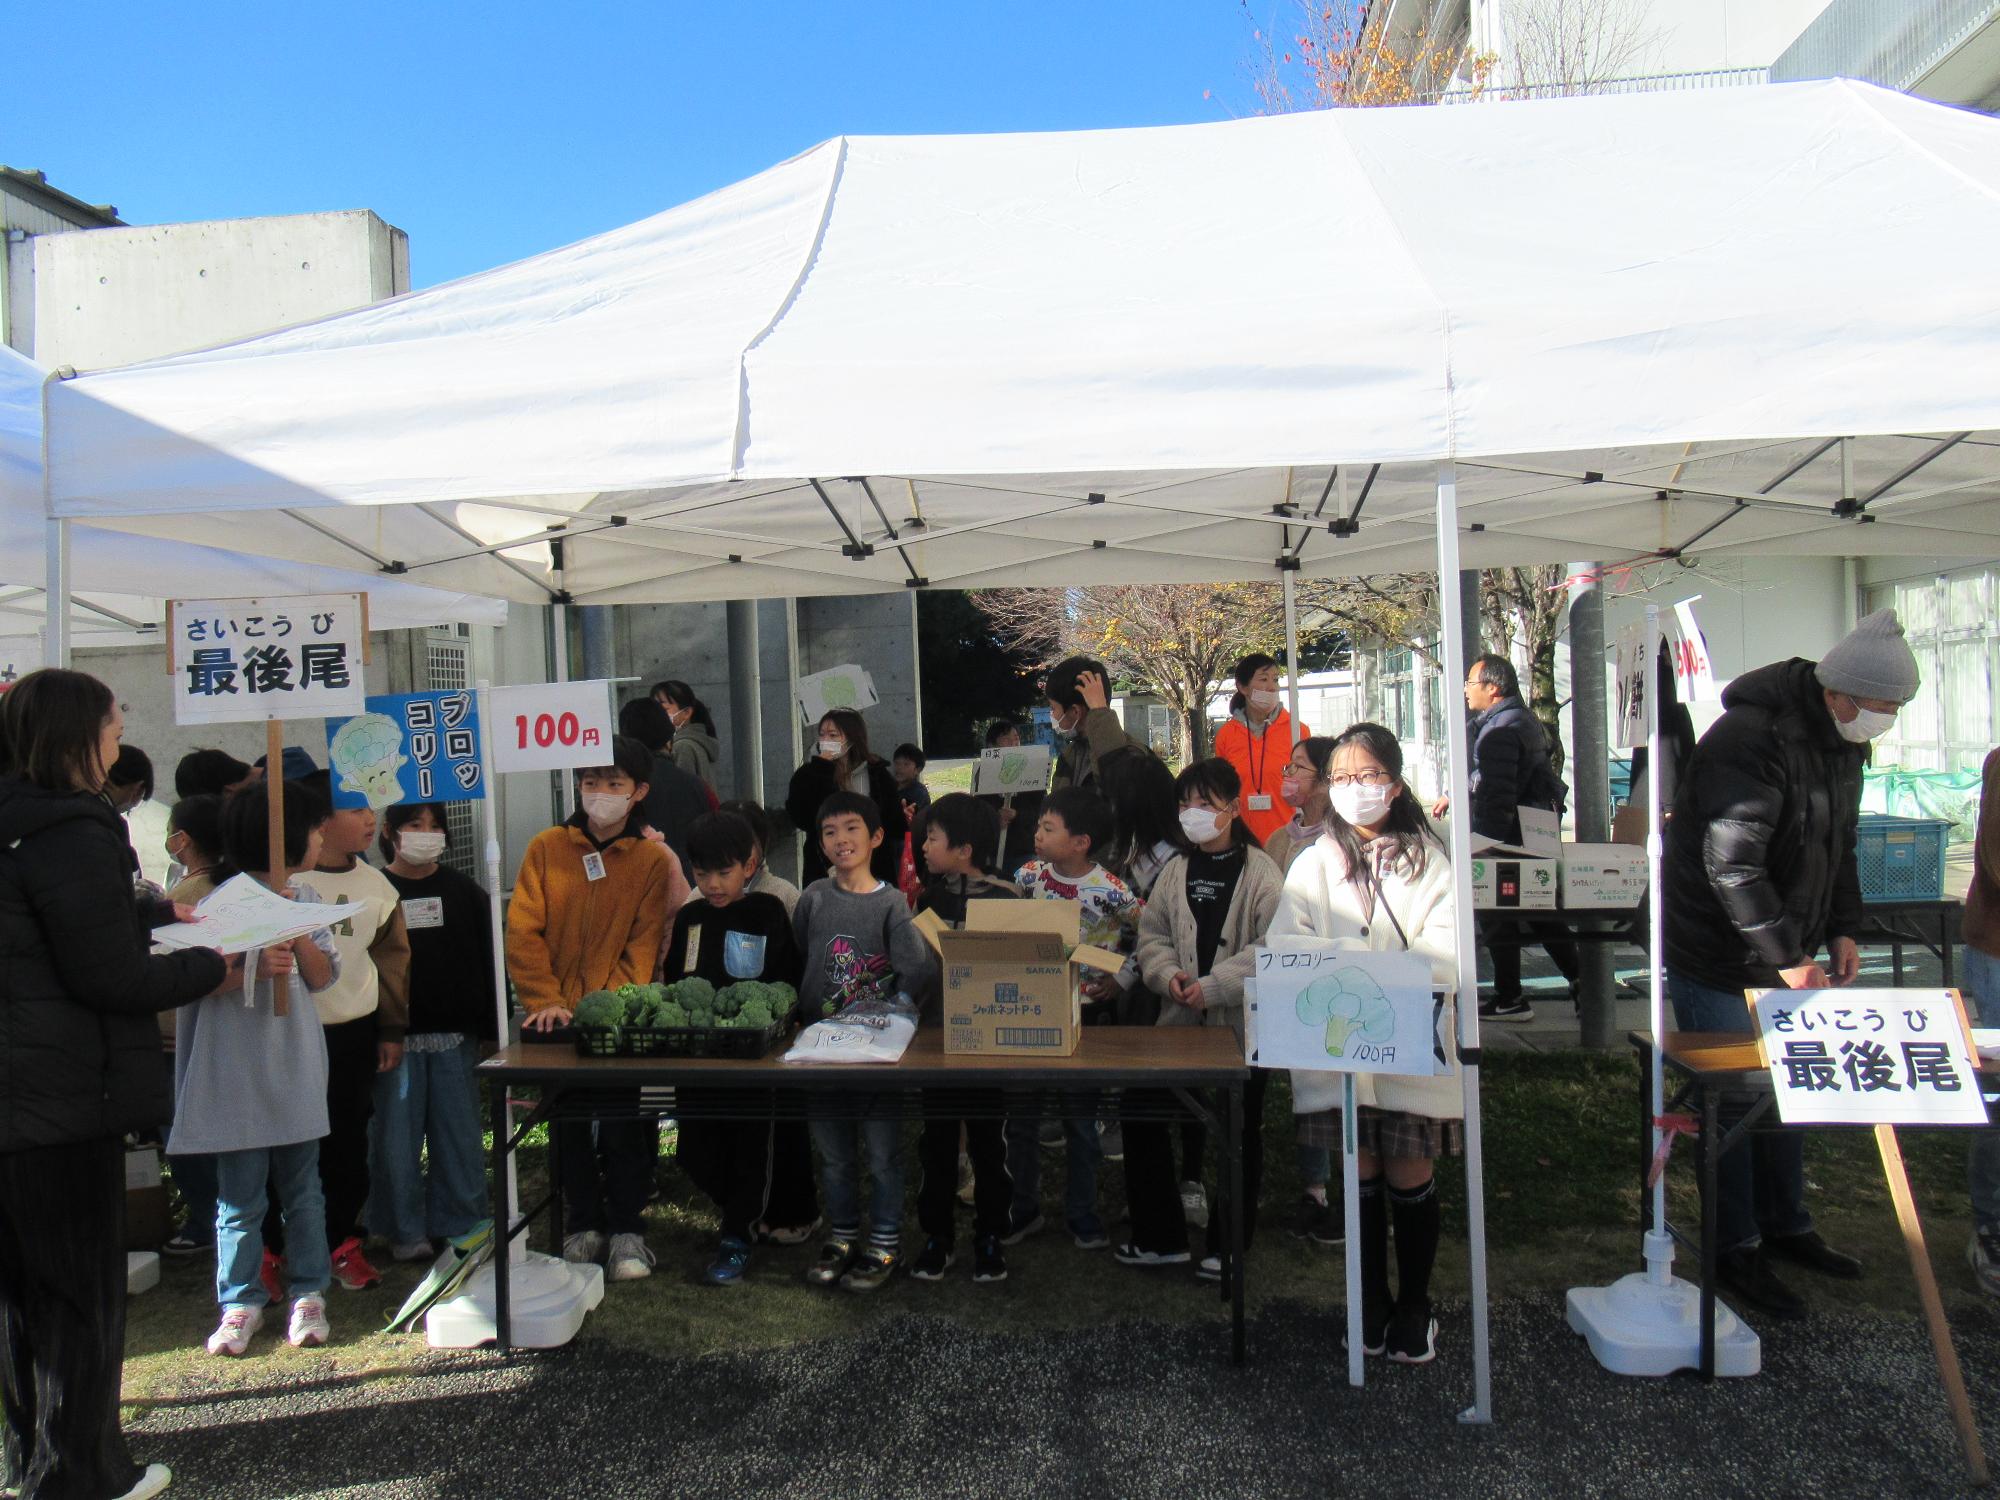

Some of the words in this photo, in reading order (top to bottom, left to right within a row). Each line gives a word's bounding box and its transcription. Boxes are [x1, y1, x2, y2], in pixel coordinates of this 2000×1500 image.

[186, 612, 335, 641] さいこうび
[186, 643, 350, 695] 最後尾
[438, 690, 481, 791] ブロッ
[515, 711, 601, 749] 100円
[405, 699, 437, 799] コリー
[1025, 966, 1062, 975] SARAYA
[1260, 953, 1337, 970] ブロッコリー
[1771, 1008, 1928, 1032] さいこうび
[1352, 1044, 1396, 1065] 100円
[1781, 1040, 1962, 1092] 最後尾
